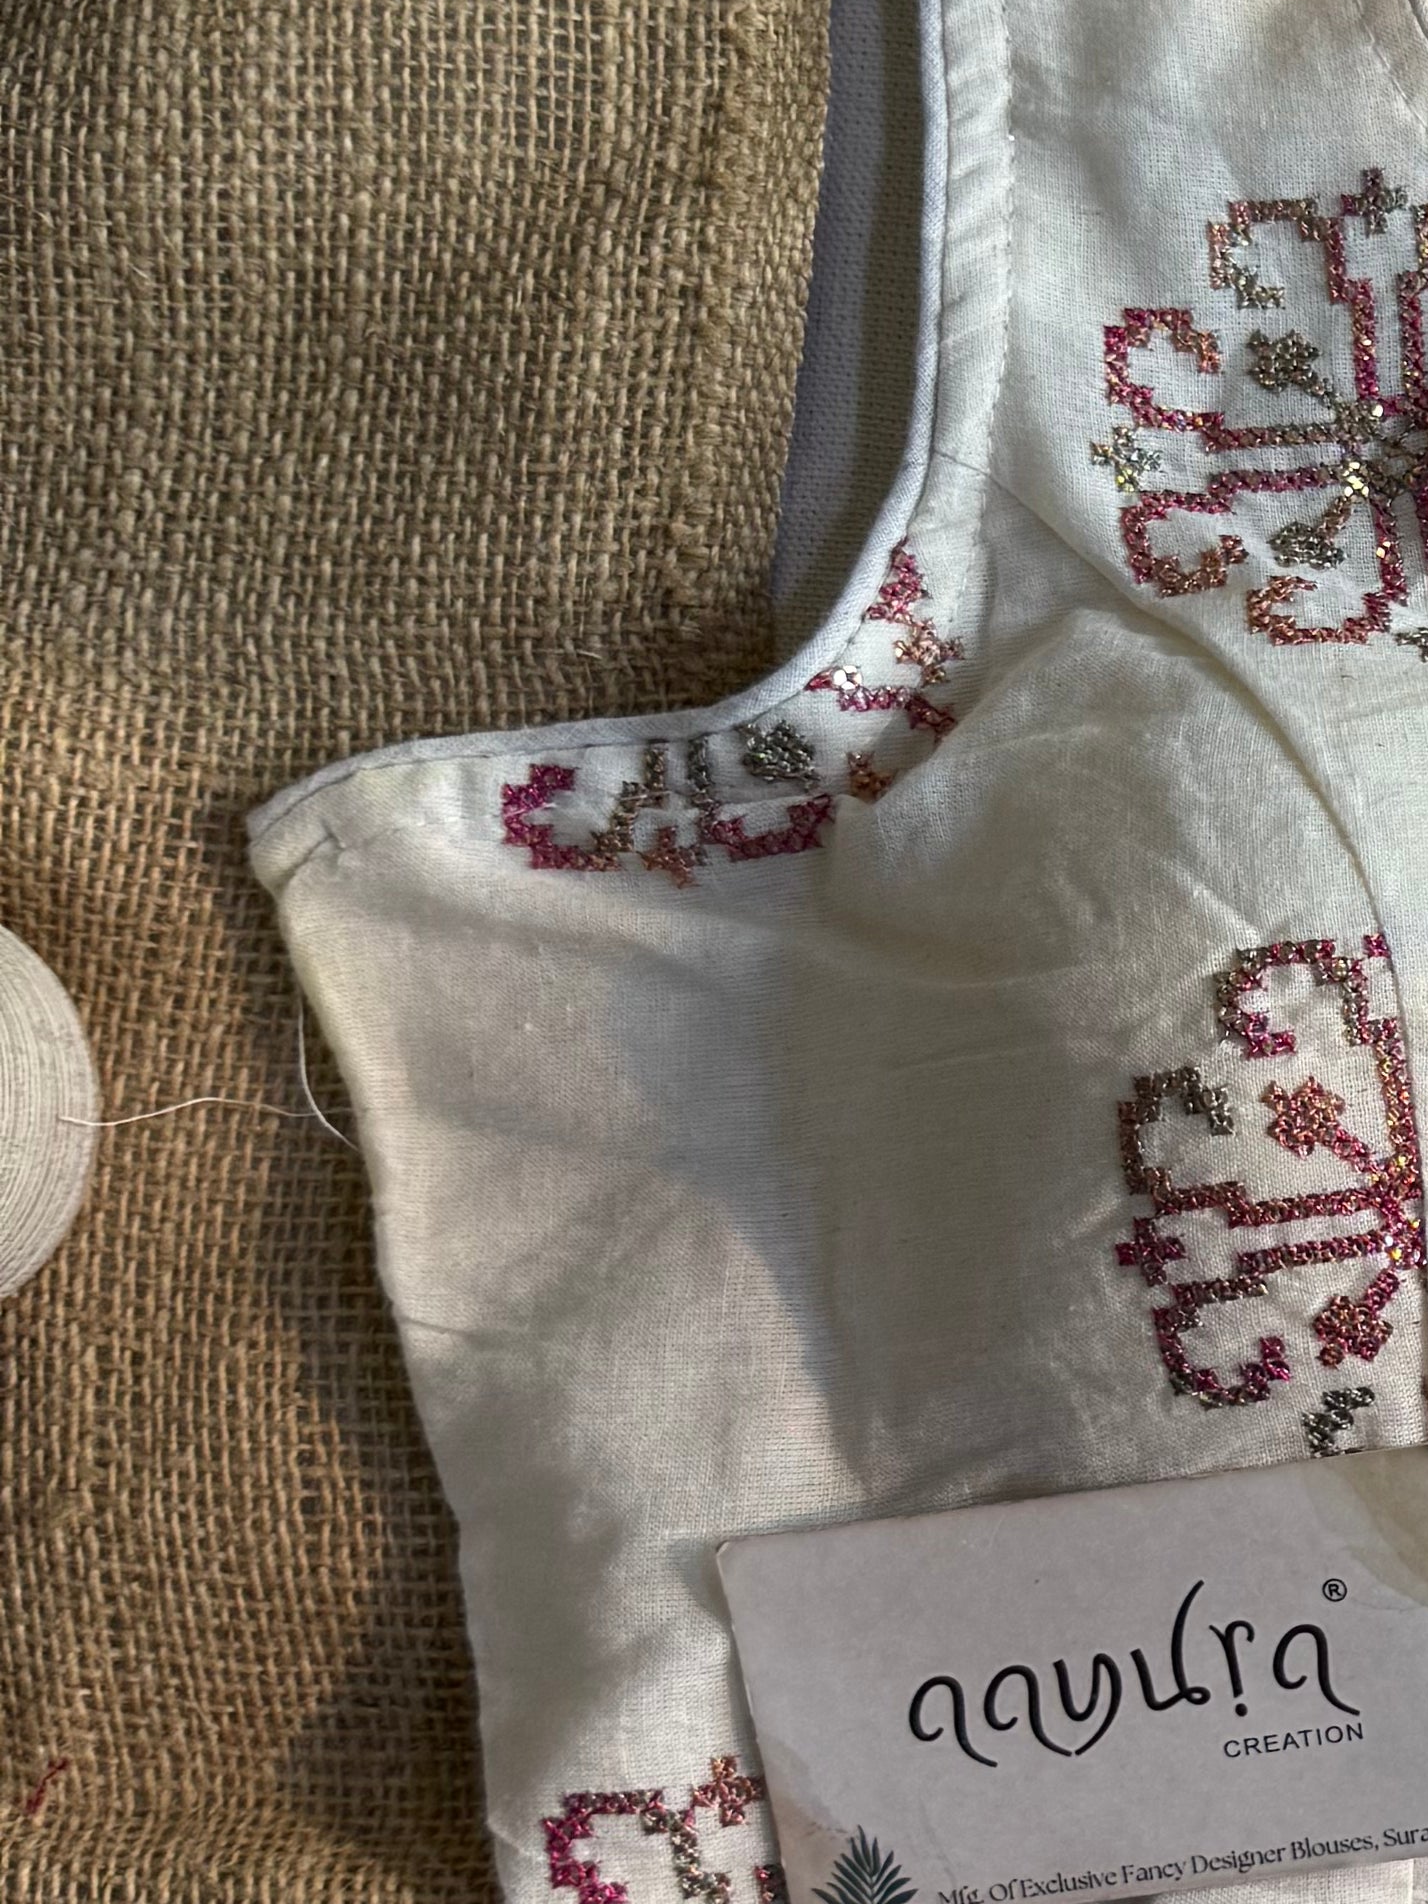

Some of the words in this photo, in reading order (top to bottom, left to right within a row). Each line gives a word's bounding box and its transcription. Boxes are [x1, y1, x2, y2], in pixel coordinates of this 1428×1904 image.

[1223, 1722, 1364, 1758] CREATION
[988, 1879, 1018, 1902] Of
[1021, 1871, 1118, 1899] Exclusive
[1121, 1862, 1187, 1884] Fancy
[1190, 1847, 1288, 1874] Designer
[1290, 1837, 1380, 1861] Blouses,
